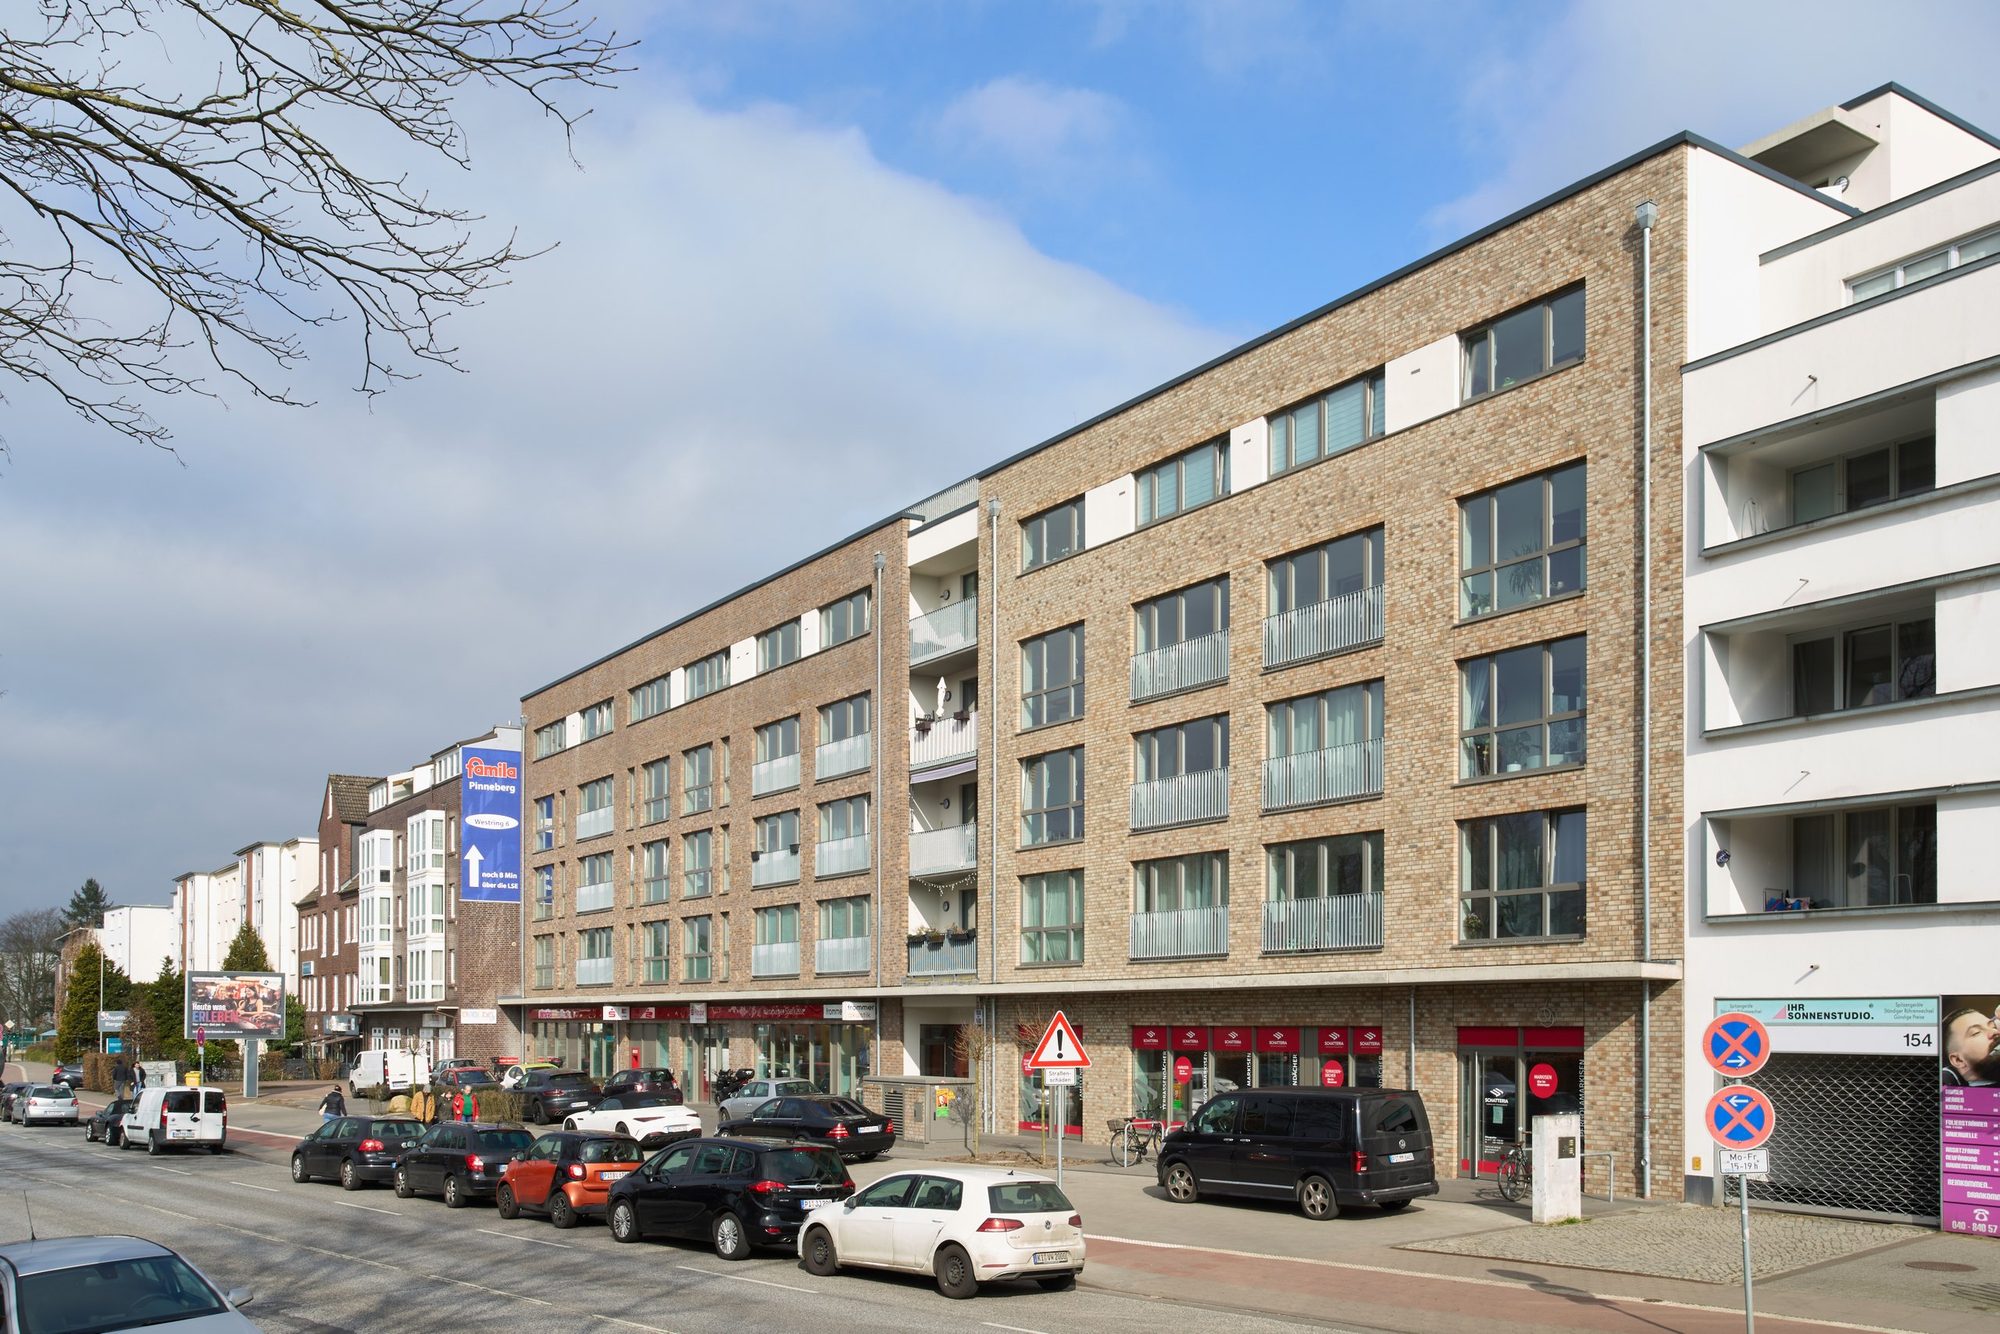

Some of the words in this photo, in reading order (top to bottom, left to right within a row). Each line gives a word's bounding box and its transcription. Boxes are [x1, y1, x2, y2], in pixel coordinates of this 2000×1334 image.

[466, 757, 517, 779] famila
[469, 781, 516, 793] Pinneberg
[474, 818, 504, 828] Westring
[192, 1003, 212, 1011] Heute
[192, 1011, 239, 1023] ERLEBEN
[1787, 1011, 1874, 1020] SONNENSTUDIO.
[1903, 1033, 1932, 1047] 154
[1730, 1153, 1757, 1161] Mo-Fr
[1952, 1220, 1966, 1230] 040
[1972, 1222, 1987, 1233] 840
[1988, 1224, 1998, 1233] 57
